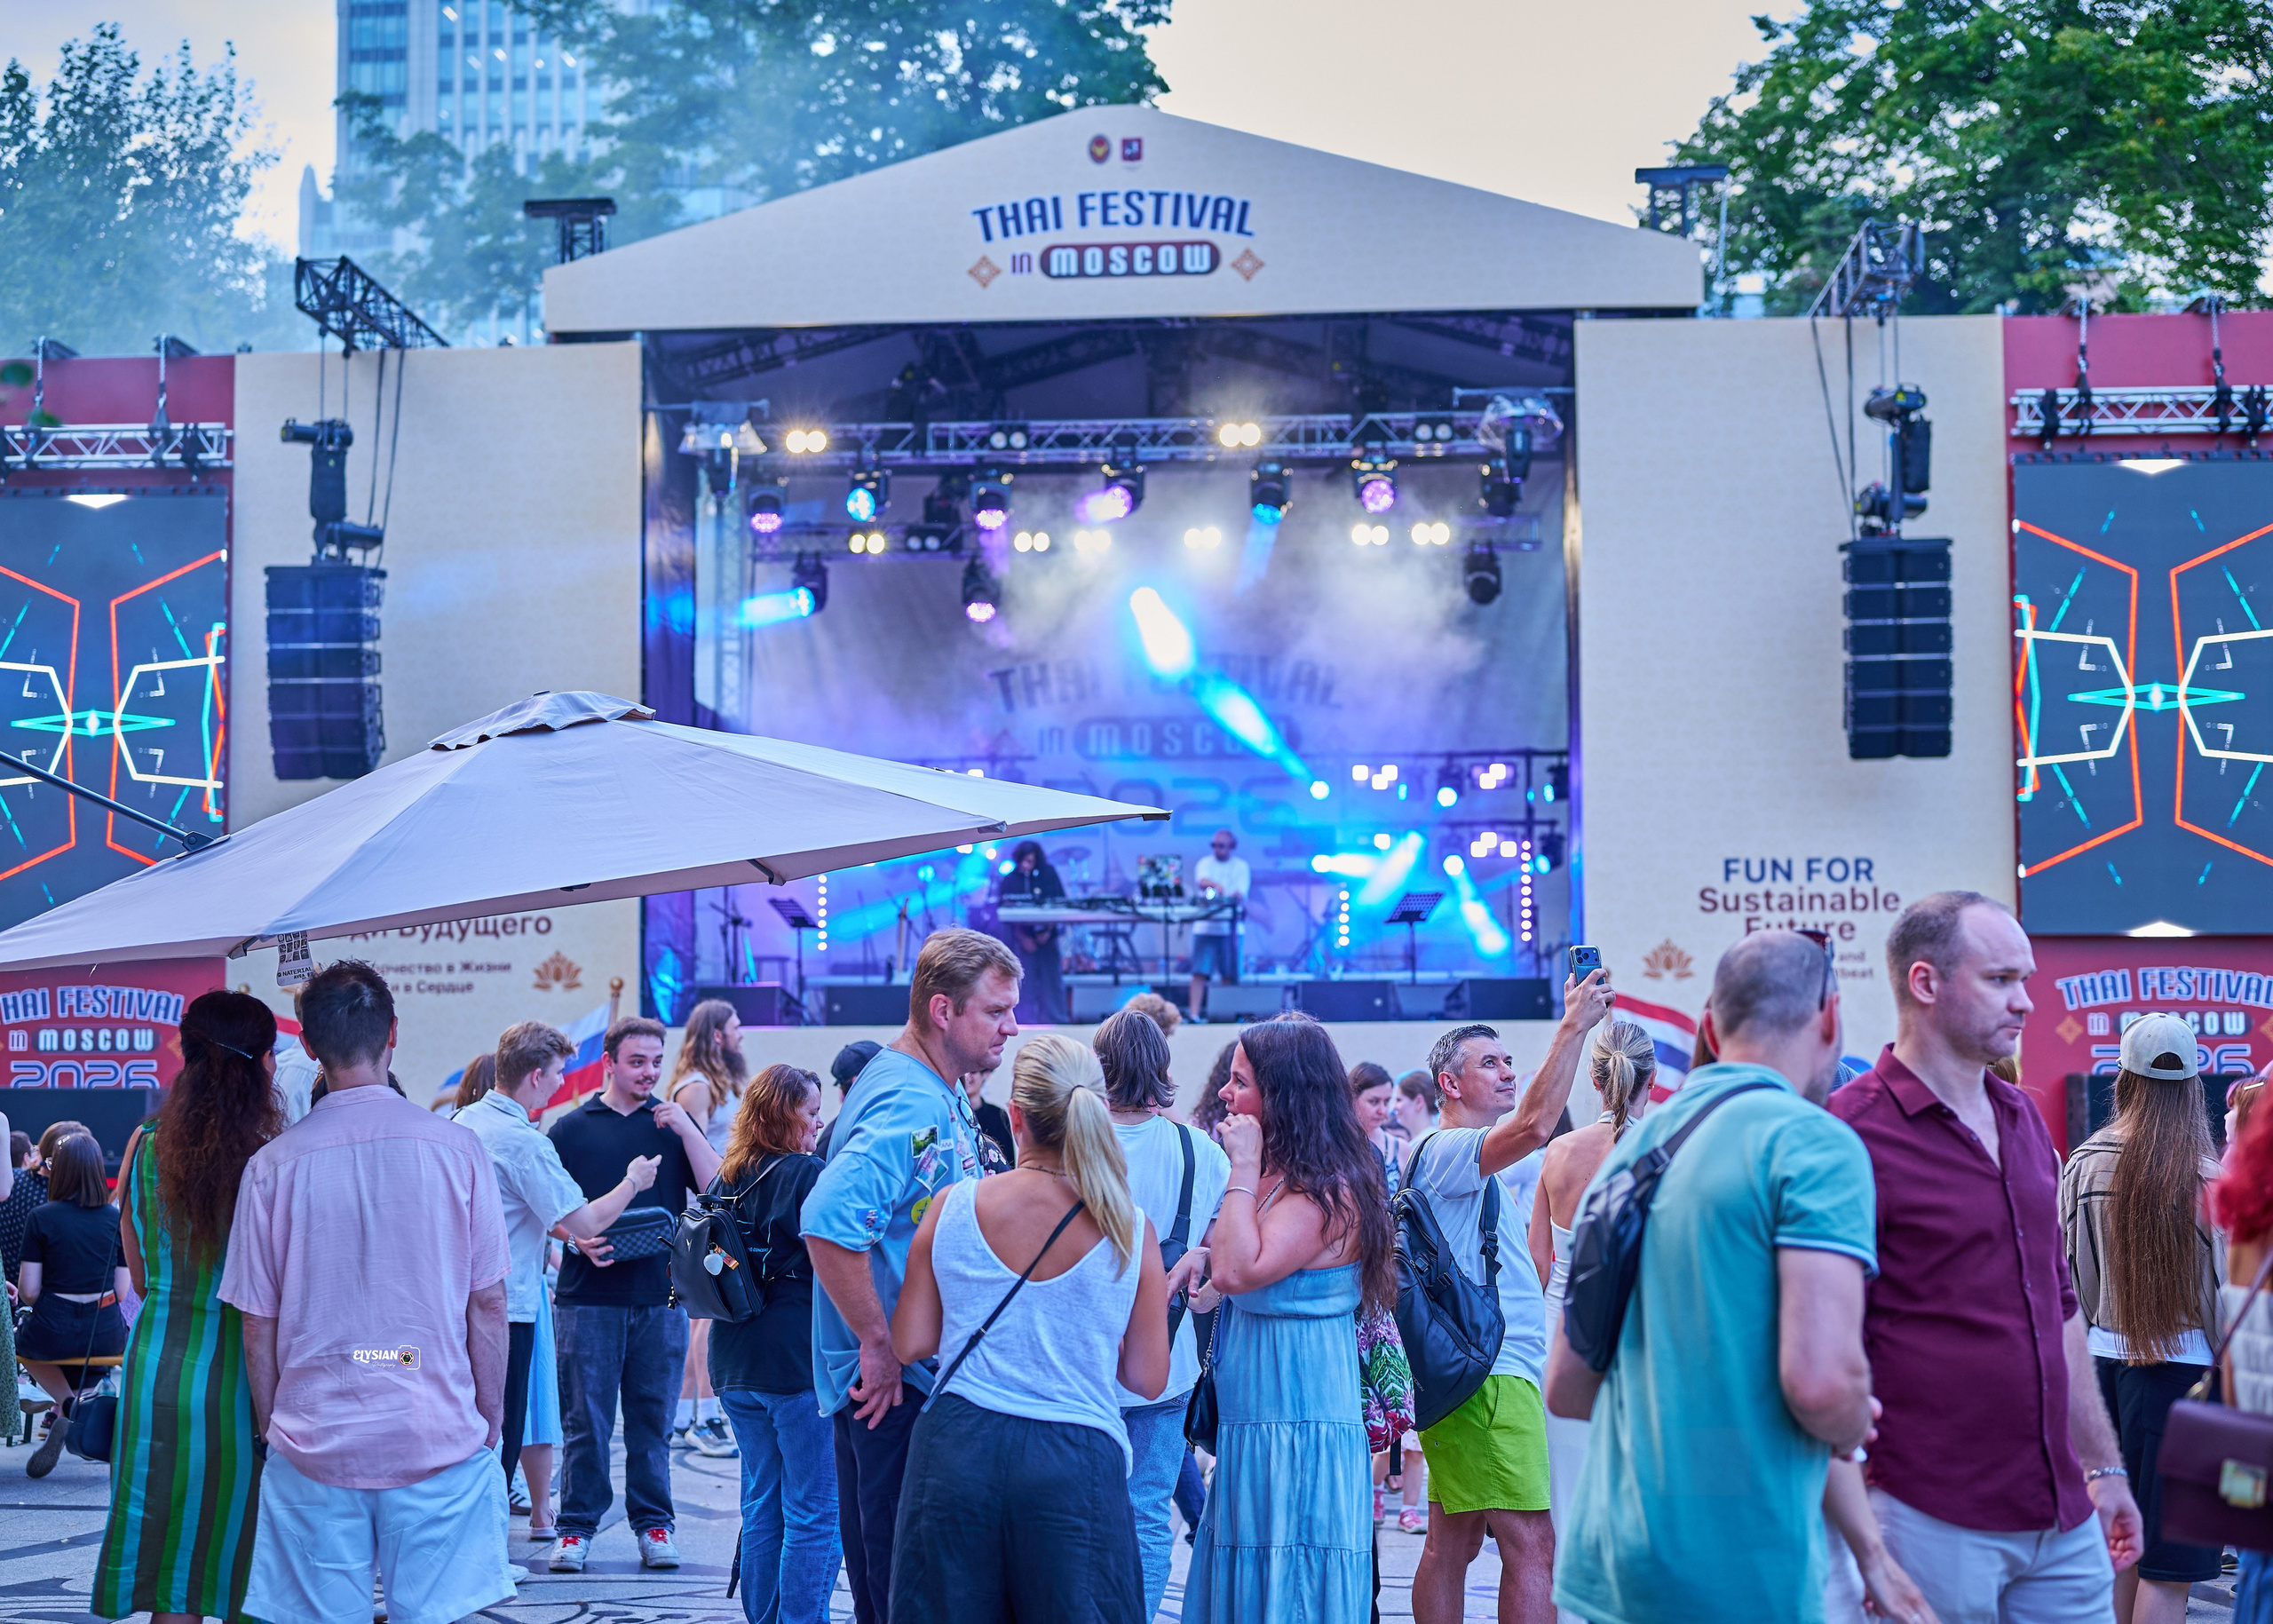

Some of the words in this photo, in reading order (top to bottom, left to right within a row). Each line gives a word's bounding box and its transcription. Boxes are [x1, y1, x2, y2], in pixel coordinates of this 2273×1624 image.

[972, 195, 1063, 242] THAI
[1077, 190, 1255, 237] FESTIVAL
[1049, 243, 1213, 276] MOSCOW
[1723, 857, 1793, 883] FUN
[1807, 857, 1874, 883] FOR
[1699, 886, 1901, 914] Sustainable
[282, 966, 313, 977] NATERIAL
[2055, 968, 2133, 1011] THAI
[0, 987, 51, 1026] HAI
[57, 984, 186, 1027] FESTIVAL
[38, 1027, 154, 1051] MOSCOW
